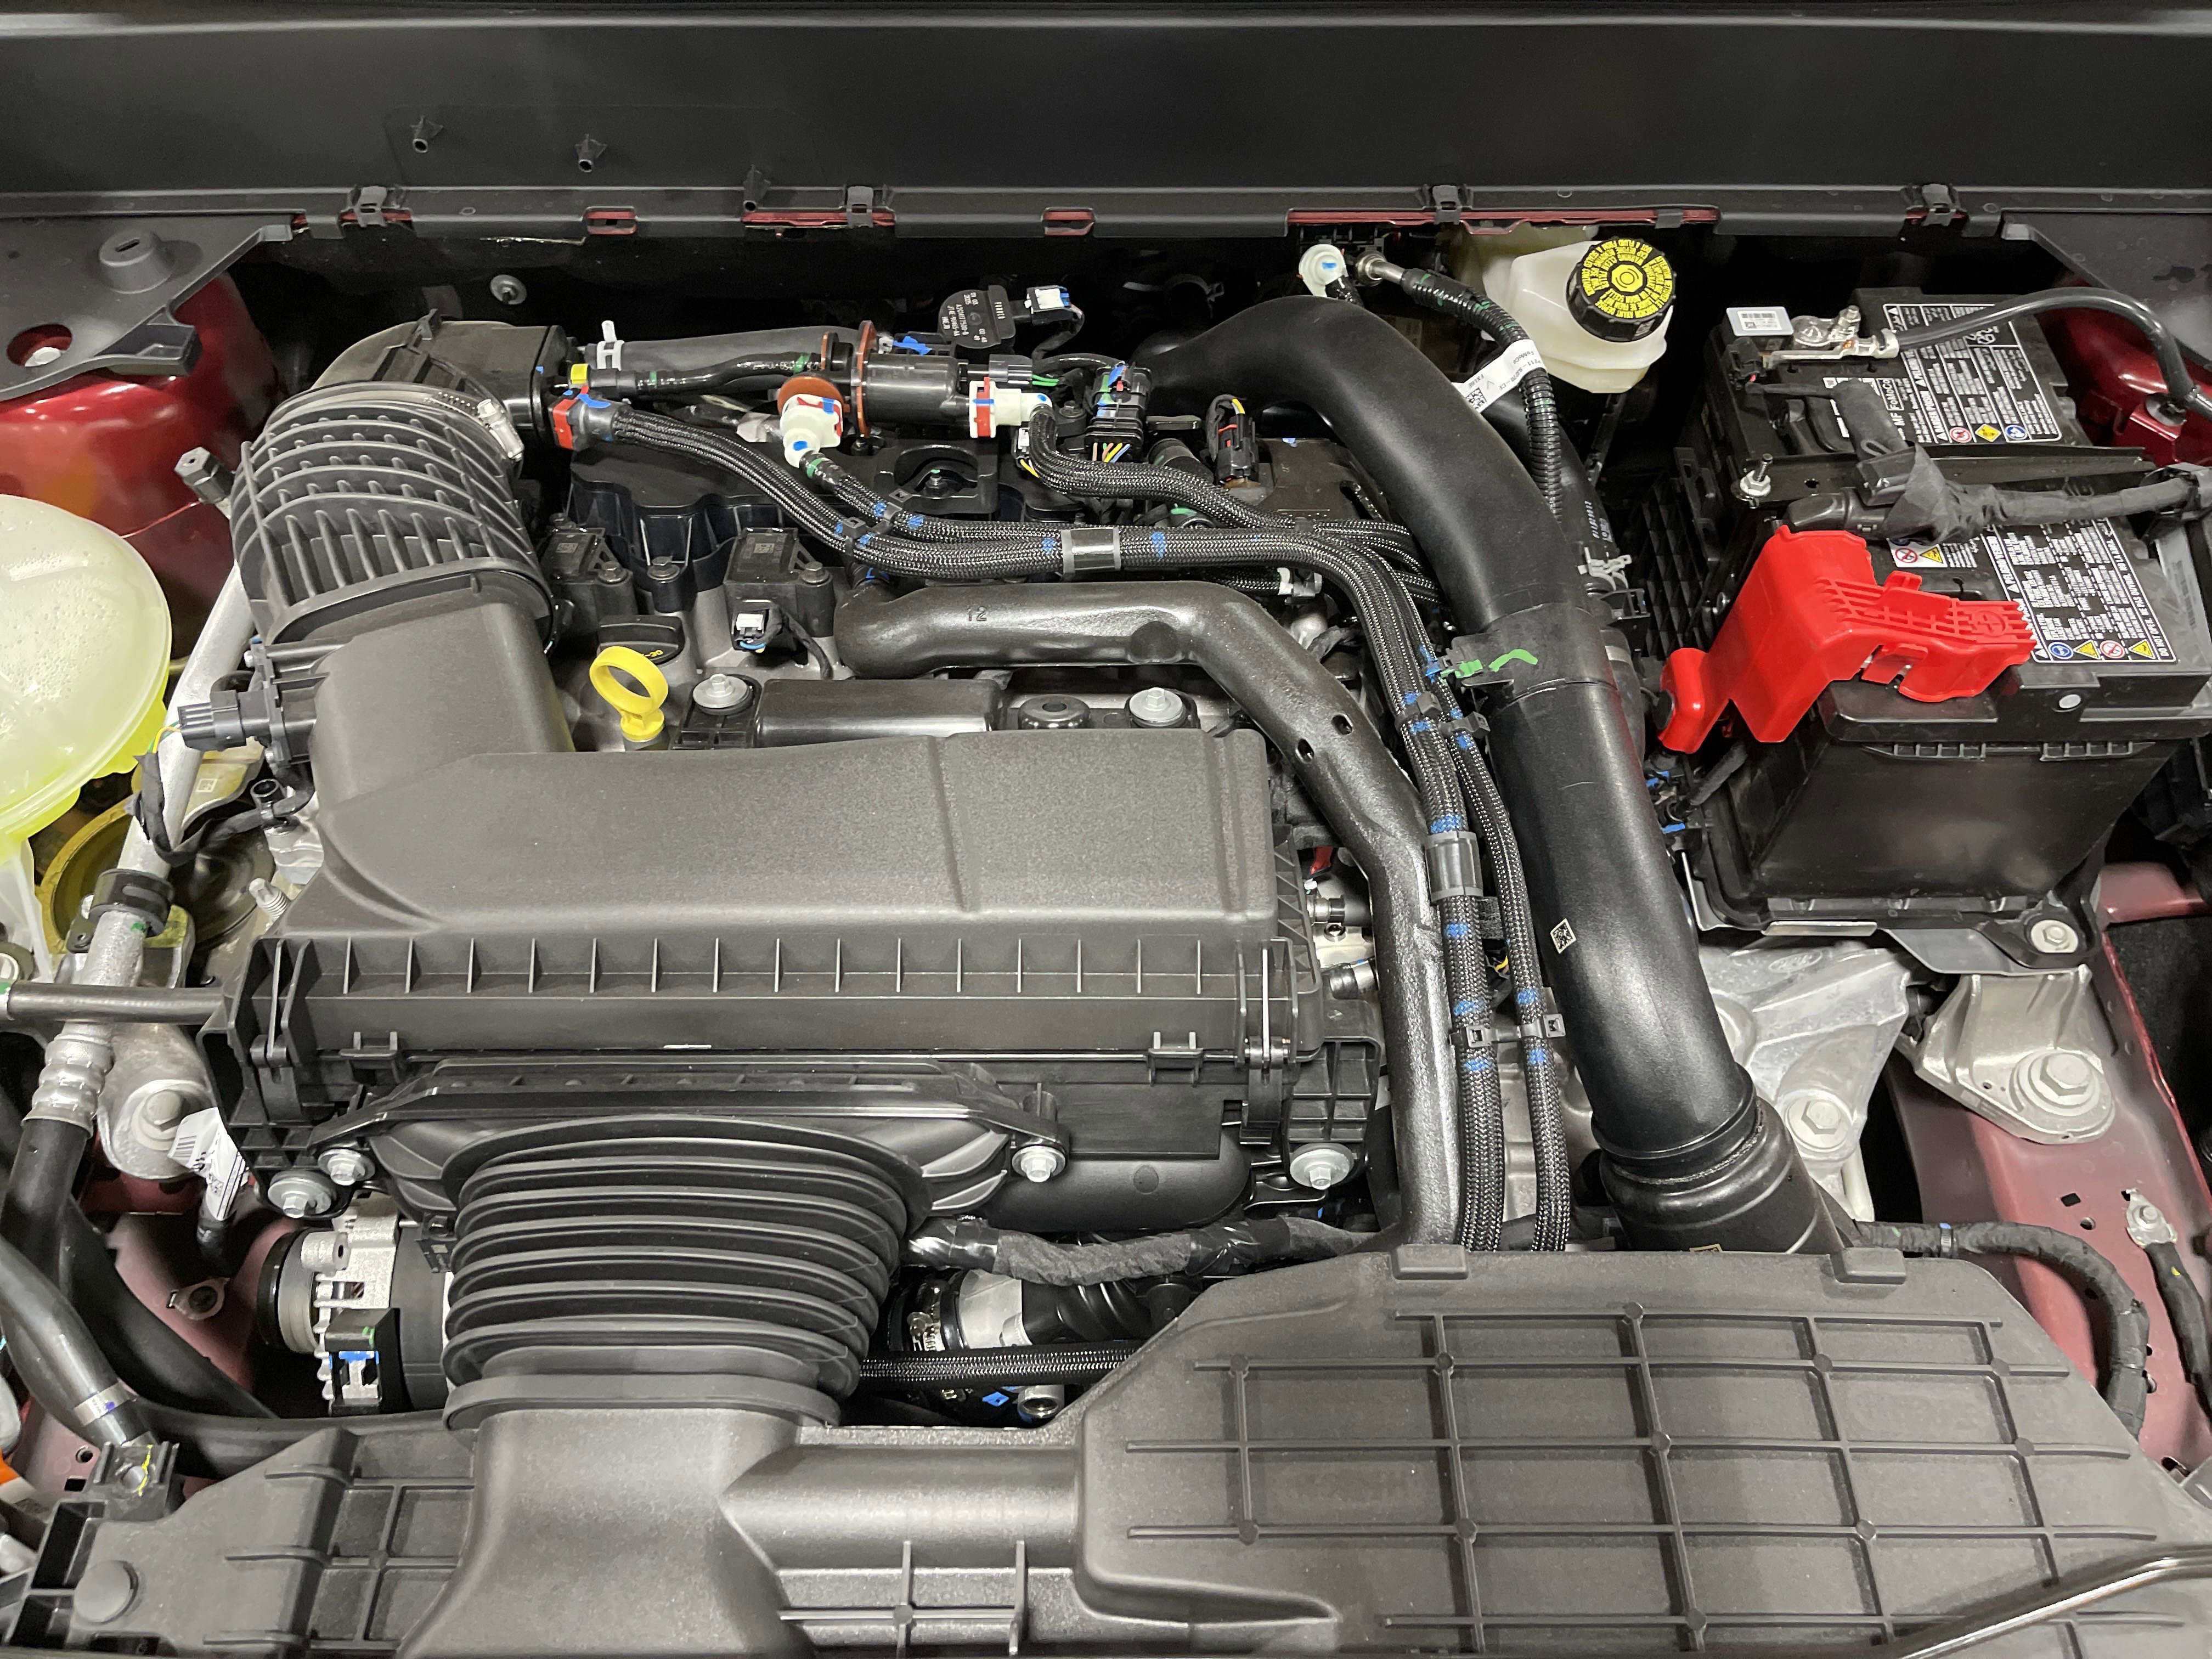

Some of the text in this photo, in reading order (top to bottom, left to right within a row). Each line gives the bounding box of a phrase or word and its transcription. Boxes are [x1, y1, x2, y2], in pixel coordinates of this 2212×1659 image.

[1880, 380, 1901, 409] FoMoCo
[2117, 563, 2128, 571] NO
[2133, 596, 2146, 607] PAS
[2152, 635, 2165, 647] NOT
[2158, 648, 2169, 656] DO
